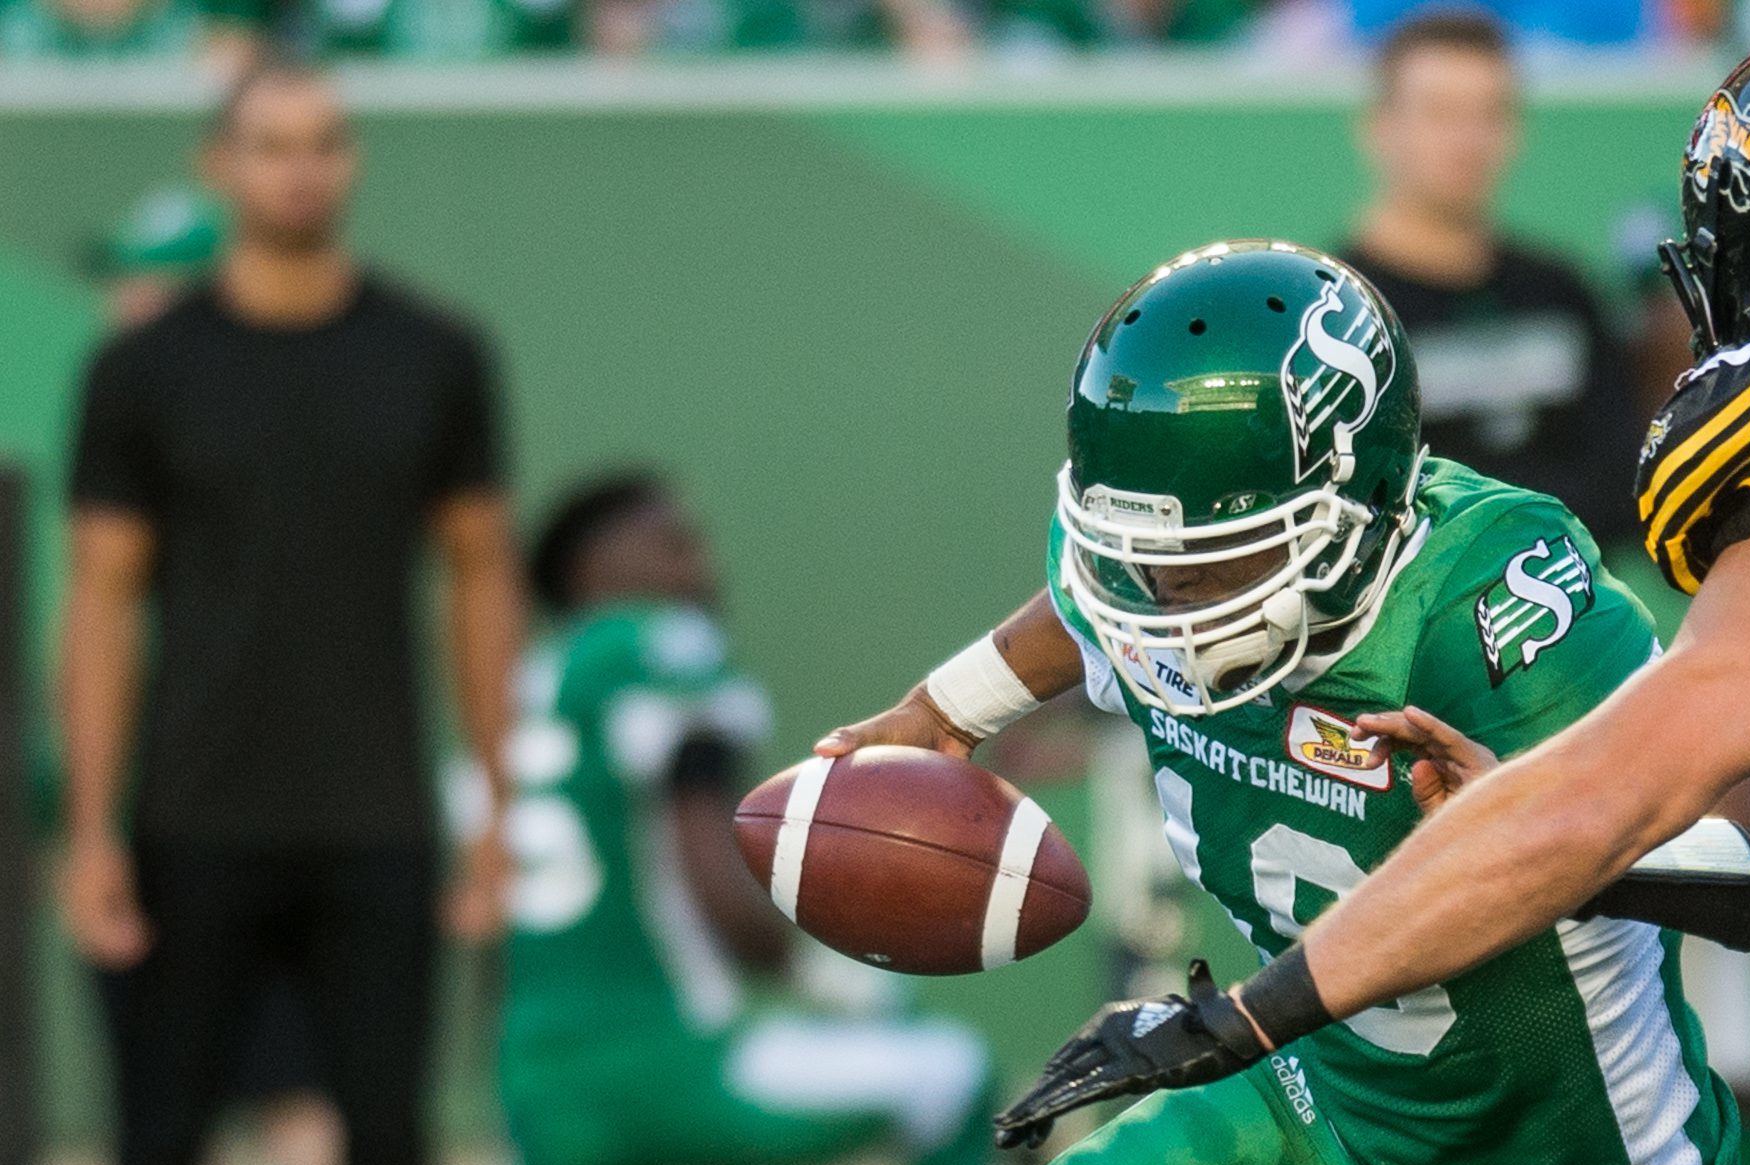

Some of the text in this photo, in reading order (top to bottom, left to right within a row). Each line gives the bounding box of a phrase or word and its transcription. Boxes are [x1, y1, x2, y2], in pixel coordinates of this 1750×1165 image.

[1110, 497, 1154, 514] RIDERS
[1156, 660, 1195, 698] TIRE
[1150, 708, 1367, 821] SASKATCHEWAN
[1313, 746, 1364, 766] DEKALB
[1270, 1054, 1317, 1126] adidas
